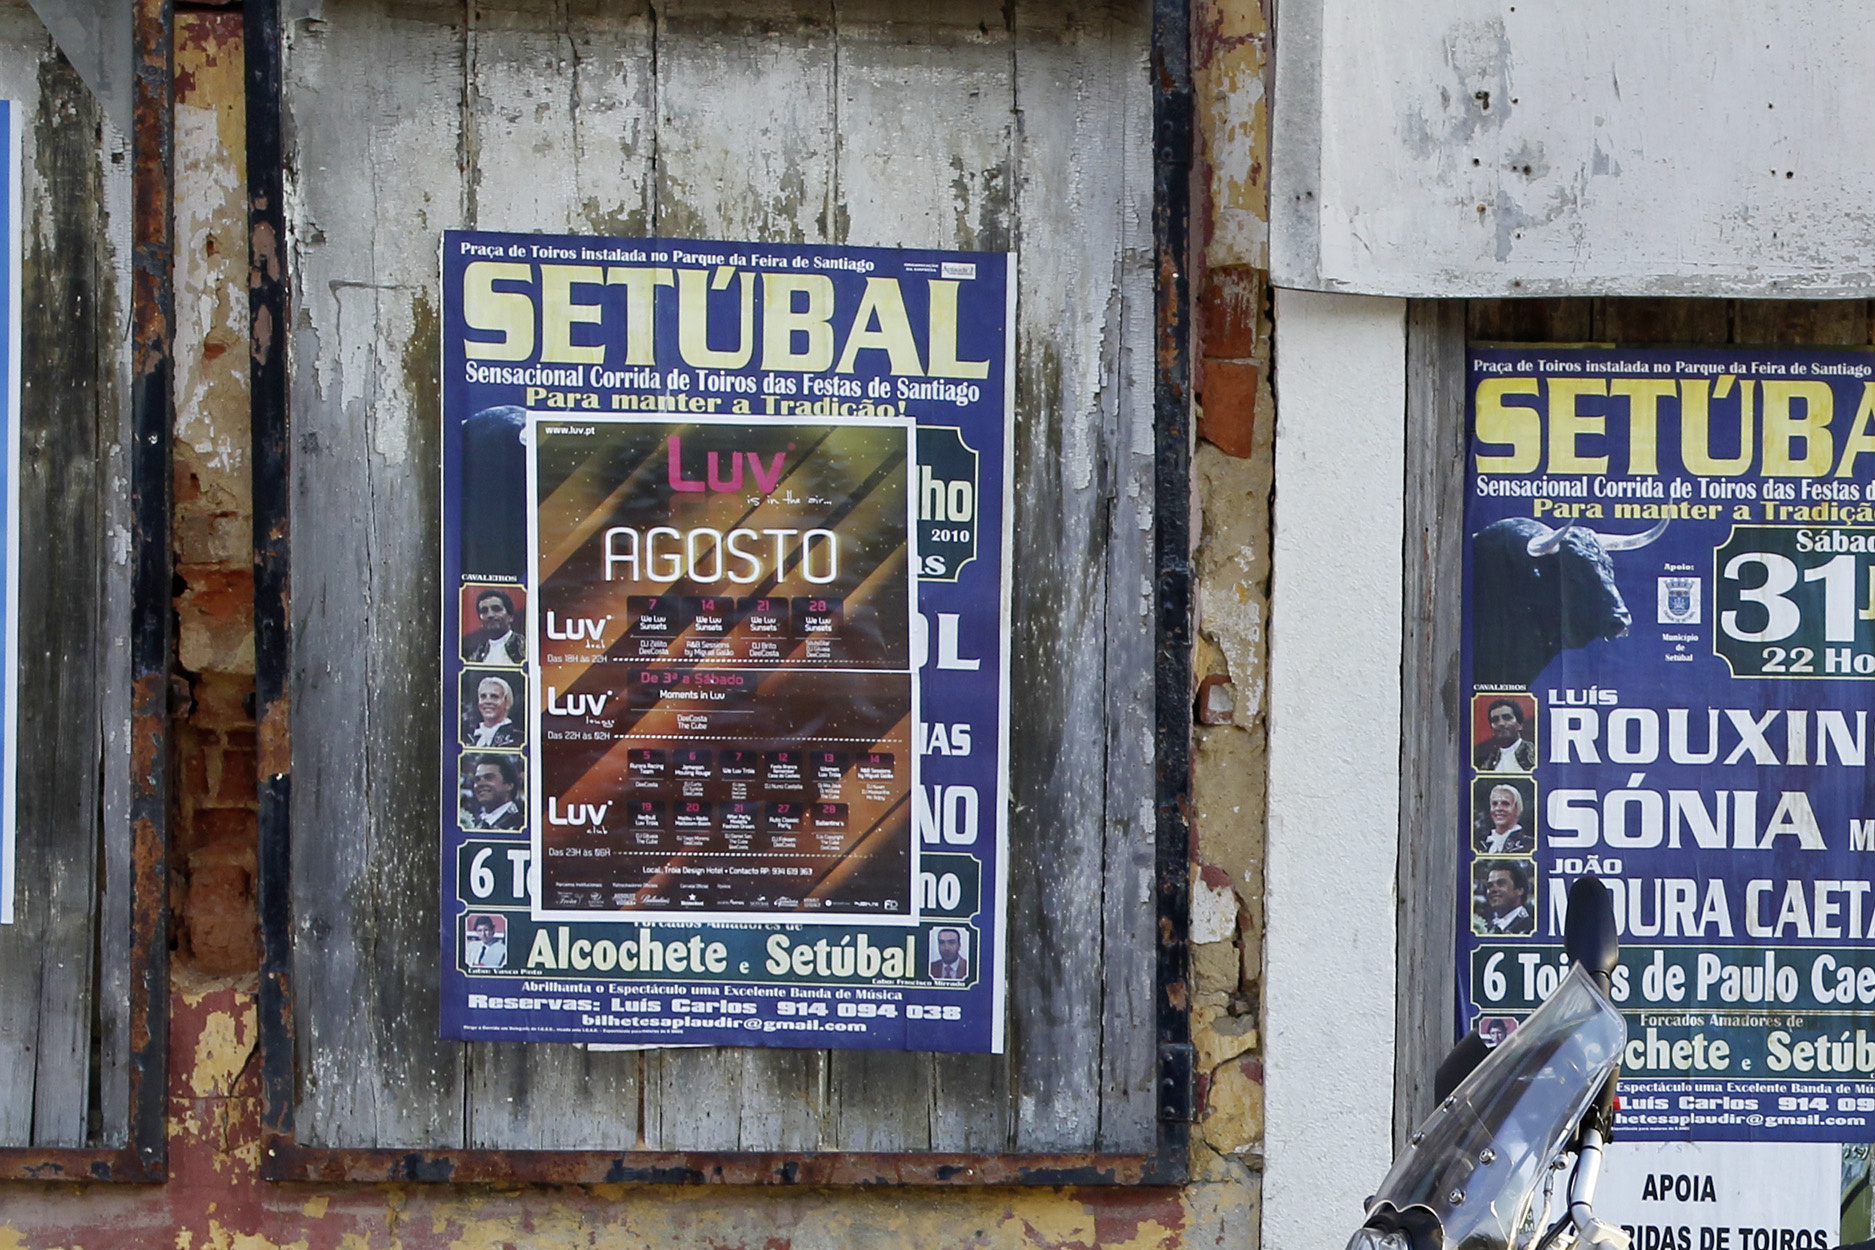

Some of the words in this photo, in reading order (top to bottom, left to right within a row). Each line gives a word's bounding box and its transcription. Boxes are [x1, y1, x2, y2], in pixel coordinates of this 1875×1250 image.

[463, 261, 990, 379] SETÚBAL
[466, 361, 583, 386] Sensacional
[590, 366, 661, 389] Corrida
[667, 368, 690, 390] de
[696, 370, 757, 393] Toiros
[762, 373, 797, 395] das
[803, 374, 861, 397] Festas
[868, 376, 891, 398] de
[897, 377, 980, 406] Santiago
[526, 387, 600, 408] Para
[611, 393, 721, 412] manter
[732, 399, 751, 414] a
[545, 426, 596, 437] www.luv.pt
[668, 435, 787, 493] Luv
[931, 529, 970, 543] 2010
[604, 526, 838, 584] AGOSTO
[1664, 563, 1694, 572] Apoio:
[1721, 552, 1856, 642] 31
[547, 611, 607, 640] Luv
[1762, 647, 1814, 673] 22
[547, 687, 607, 716] Luv
[1548, 686, 1618, 705] LUÍS
[548, 797, 607, 825] Luv
[1547, 772, 1828, 850] SÓNIA
[470, 848, 495, 898] 6
[1549, 855, 1622, 874] JOÃO
[526, 926, 727, 974] Alcochete
[739, 961, 750, 974] e
[766, 933, 915, 978] Setúbal
[1483, 952, 1506, 1001] 6
[1518, 952, 1630, 1002] Tois
[1642, 950, 1686, 1002] de
[1697, 950, 1799, 1003] Paulo
[468, 994, 600, 1011] Reservas:
[611, 997, 661, 1013] Luís
[671, 998, 758, 1014] Carlos
[777, 1001, 829, 1016] 914
[837, 1002, 898, 1018] 094
[906, 1004, 962, 1020] 038
[582, 1014, 867, 1032] bilhetesaplaudir@gmail.com
[1621, 1028, 1730, 1071] chete
[1741, 1058, 1751, 1070] e
[1642, 1174, 1717, 1203] APOIA
